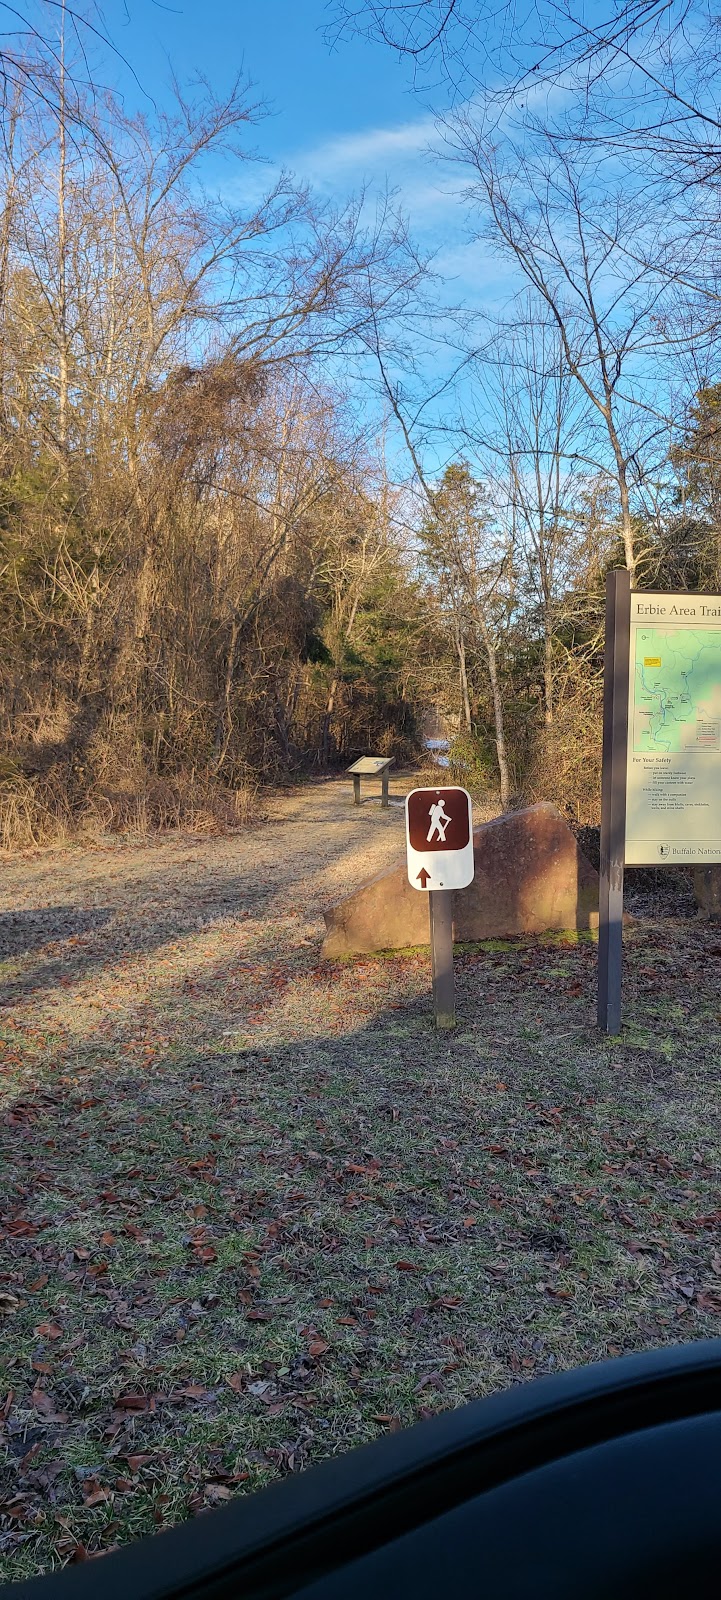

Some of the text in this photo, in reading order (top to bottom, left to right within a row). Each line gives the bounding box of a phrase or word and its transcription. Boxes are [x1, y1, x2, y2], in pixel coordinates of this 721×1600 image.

[636, 604, 666, 615] Erbie
[669, 605, 696, 616] Area
[655, 757, 672, 765] Safety
